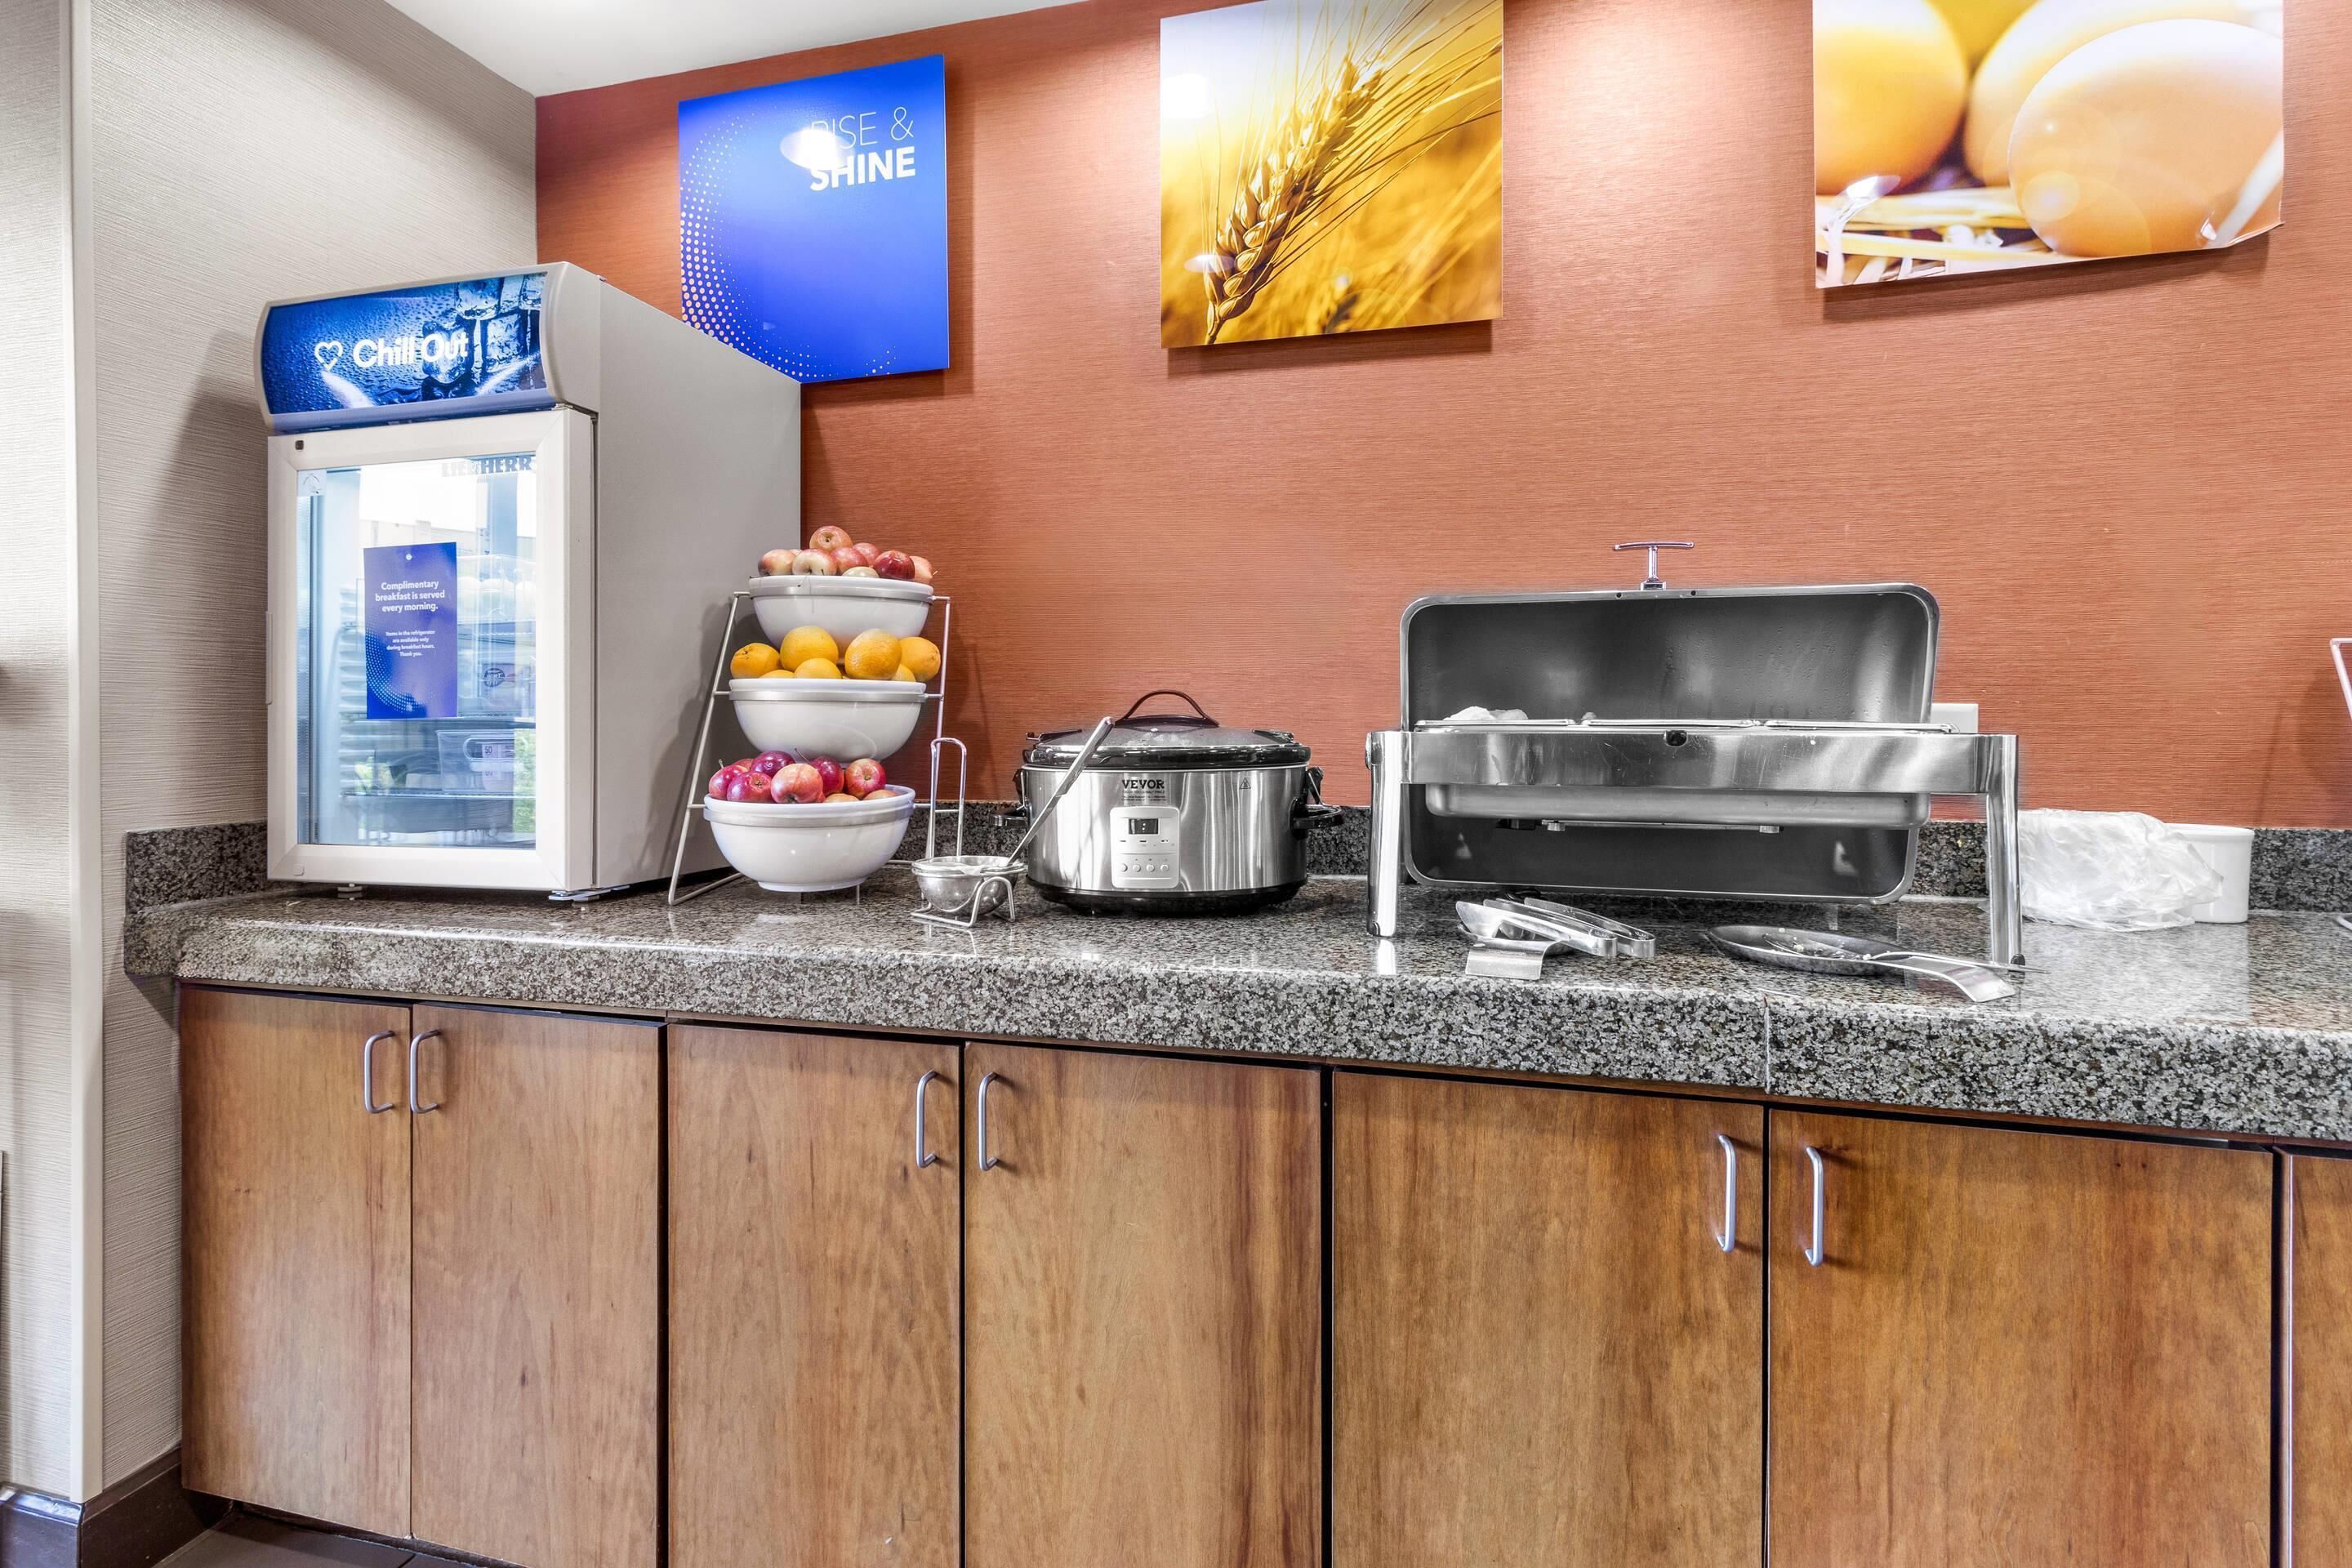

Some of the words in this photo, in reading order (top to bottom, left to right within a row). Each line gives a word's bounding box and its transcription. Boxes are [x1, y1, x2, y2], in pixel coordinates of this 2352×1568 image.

[890, 106, 914, 141] &
[810, 145, 916, 191] SHINE
[353, 336, 415, 368] Chill
[421, 332, 469, 362] Out
[381, 581, 439, 591] Complimentary
[375, 592, 411, 602] breakfast
[412, 591, 418, 599] is
[419, 590, 445, 599] served
[381, 605, 403, 613] every
[404, 602, 439, 612] morning.
[1121, 779, 1165, 789] VEVOR
